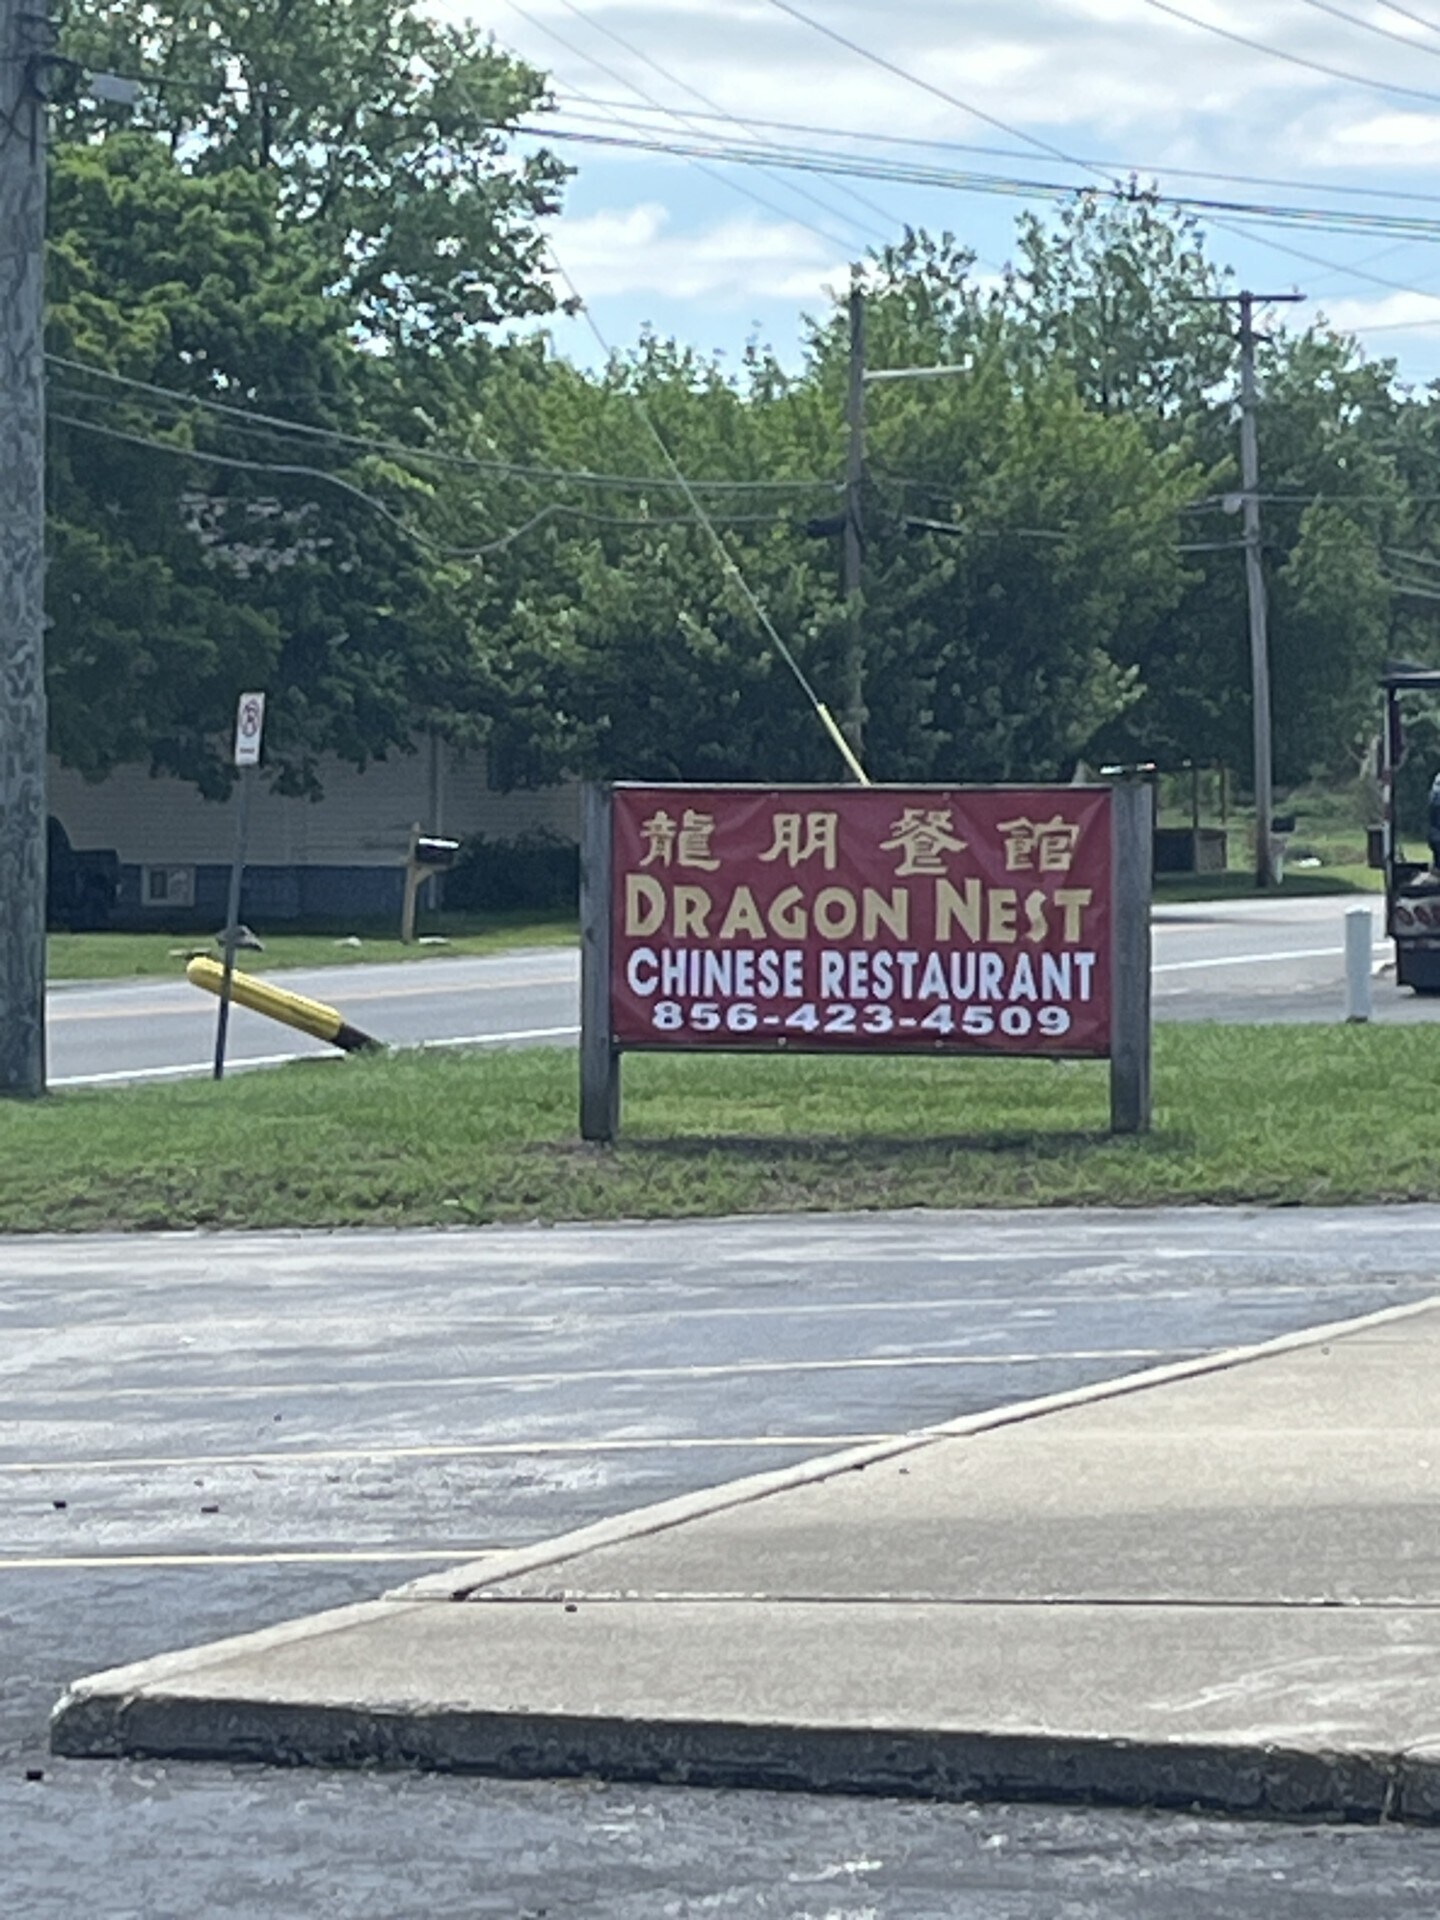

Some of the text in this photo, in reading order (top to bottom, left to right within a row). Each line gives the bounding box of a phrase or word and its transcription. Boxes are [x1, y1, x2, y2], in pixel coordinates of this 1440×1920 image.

[627, 948, 1095, 1001] CHINESE RESTAURANT
[652, 1002, 1071, 1035] 856-423-4509
